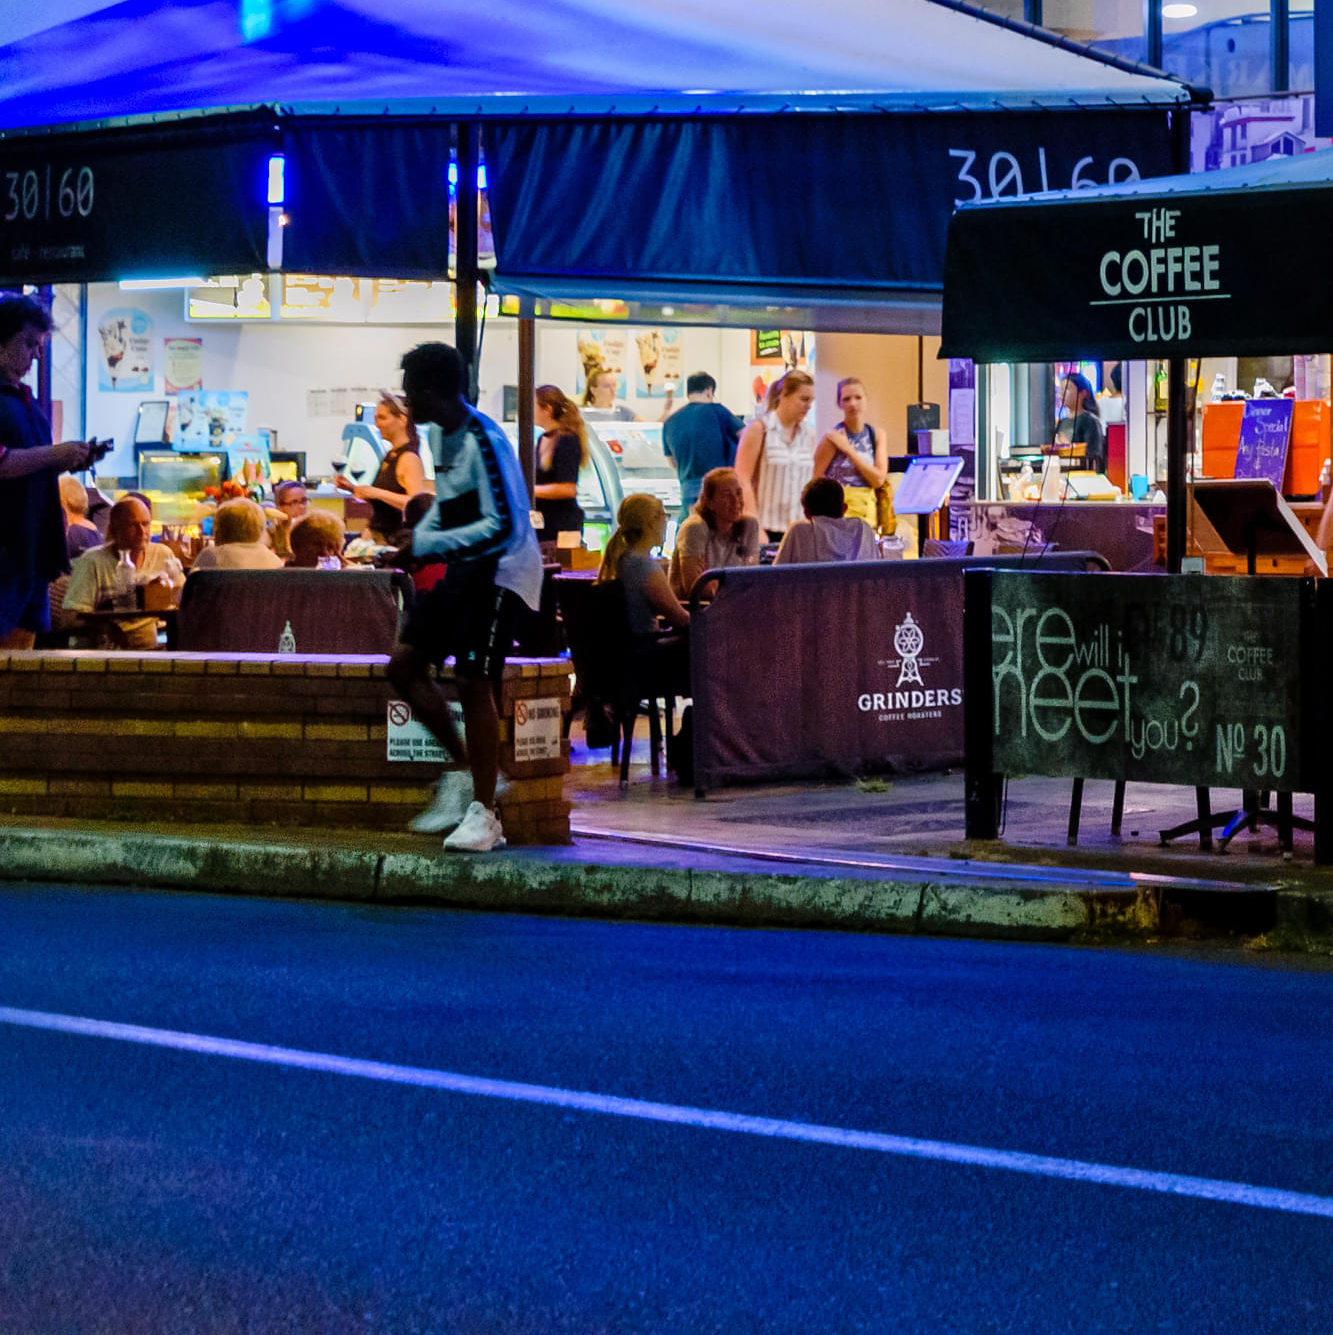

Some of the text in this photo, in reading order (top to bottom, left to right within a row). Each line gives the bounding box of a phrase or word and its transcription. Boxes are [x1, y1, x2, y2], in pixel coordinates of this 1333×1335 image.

[1135, 208, 1181, 243] THE
[1099, 244, 1220, 296] COFFEE
[1128, 305, 1192, 343] CLUB
[1074, 623, 1110, 666] will
[1227, 645, 1273, 665] COFFEE
[1238, 668, 1264, 681] CLUB
[857, 688, 963, 712] GRINDERS
[878, 710, 942, 722] COFFEE ROASTERS
[1253, 724, 1286, 777] 30
